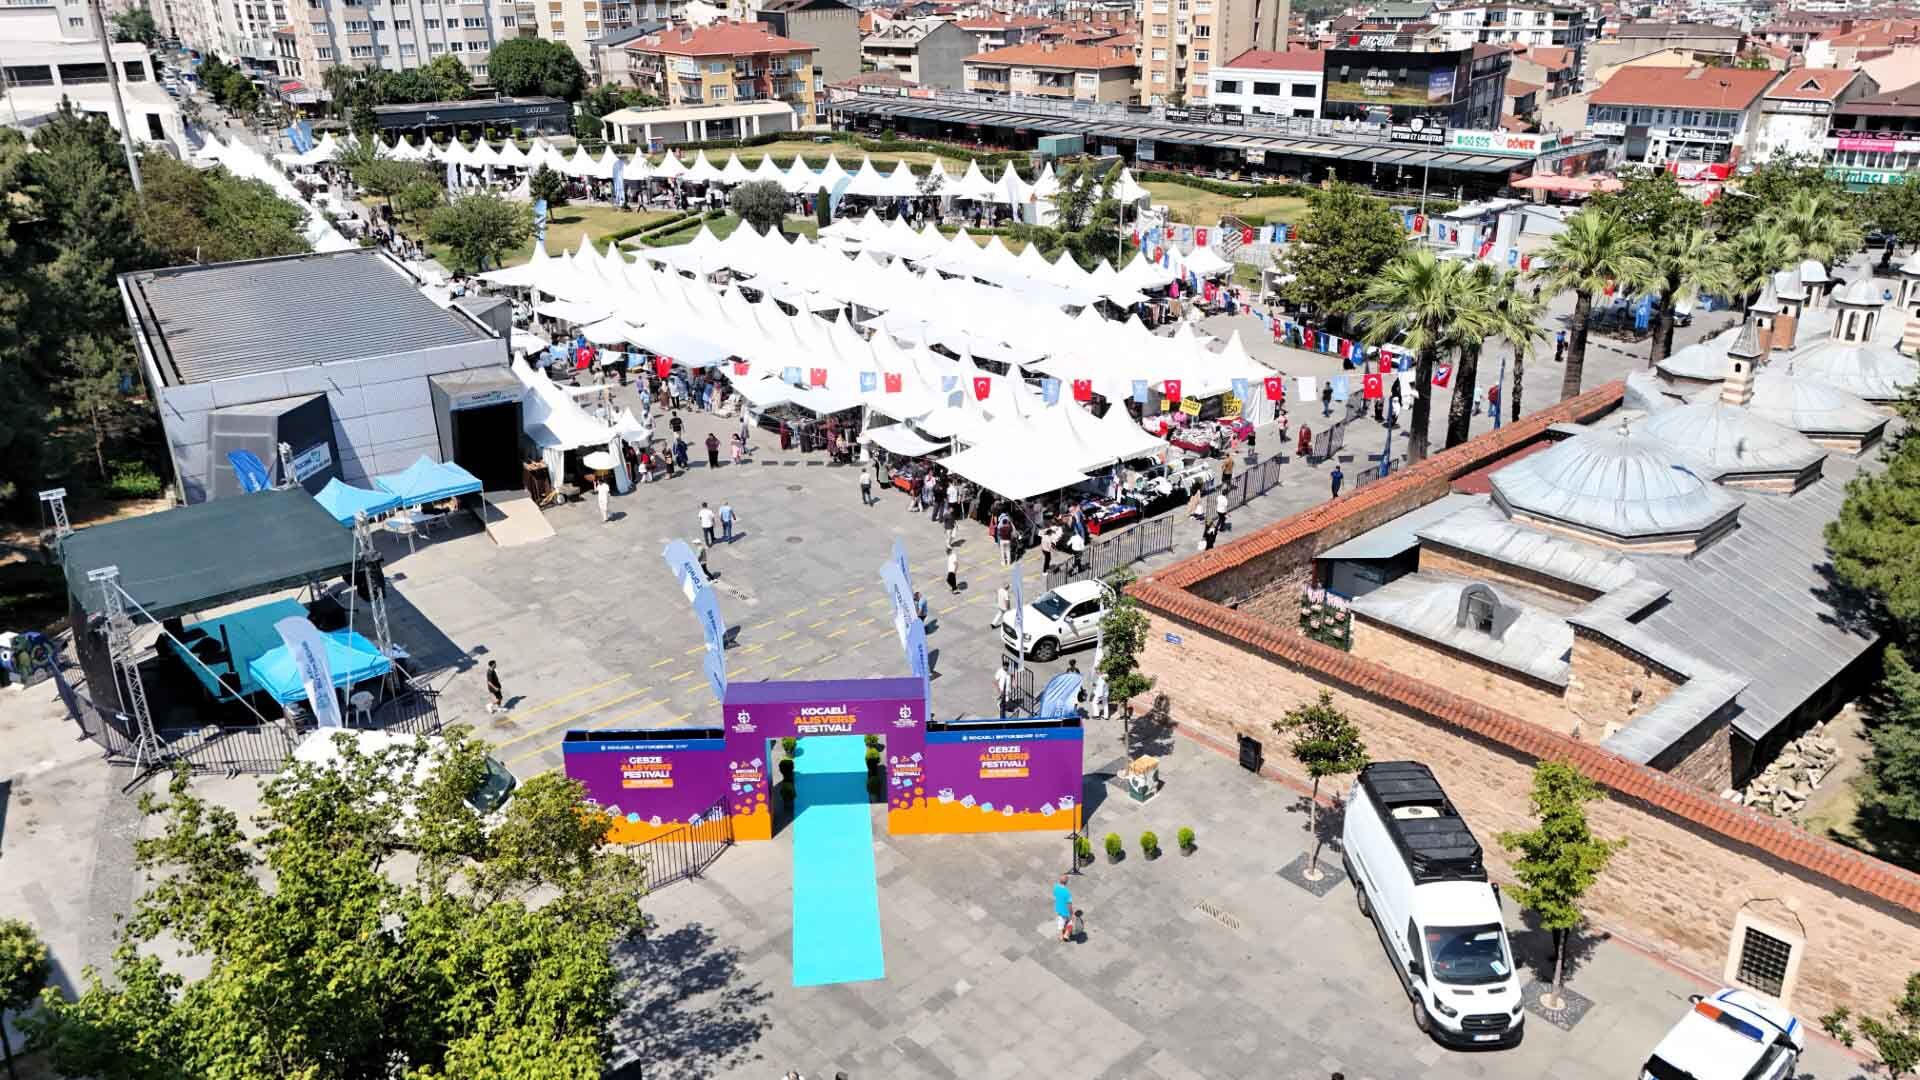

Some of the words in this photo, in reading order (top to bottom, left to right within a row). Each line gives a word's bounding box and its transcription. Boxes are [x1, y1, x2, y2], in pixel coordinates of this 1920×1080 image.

[1360, 34, 1396, 47] arçelik
[1507, 138, 1536, 149] DÖNER
[801, 704, 847, 715] KOCAELİ
[988, 746, 1021, 754] GEBZE
[628, 756, 663, 764] GEBZE
